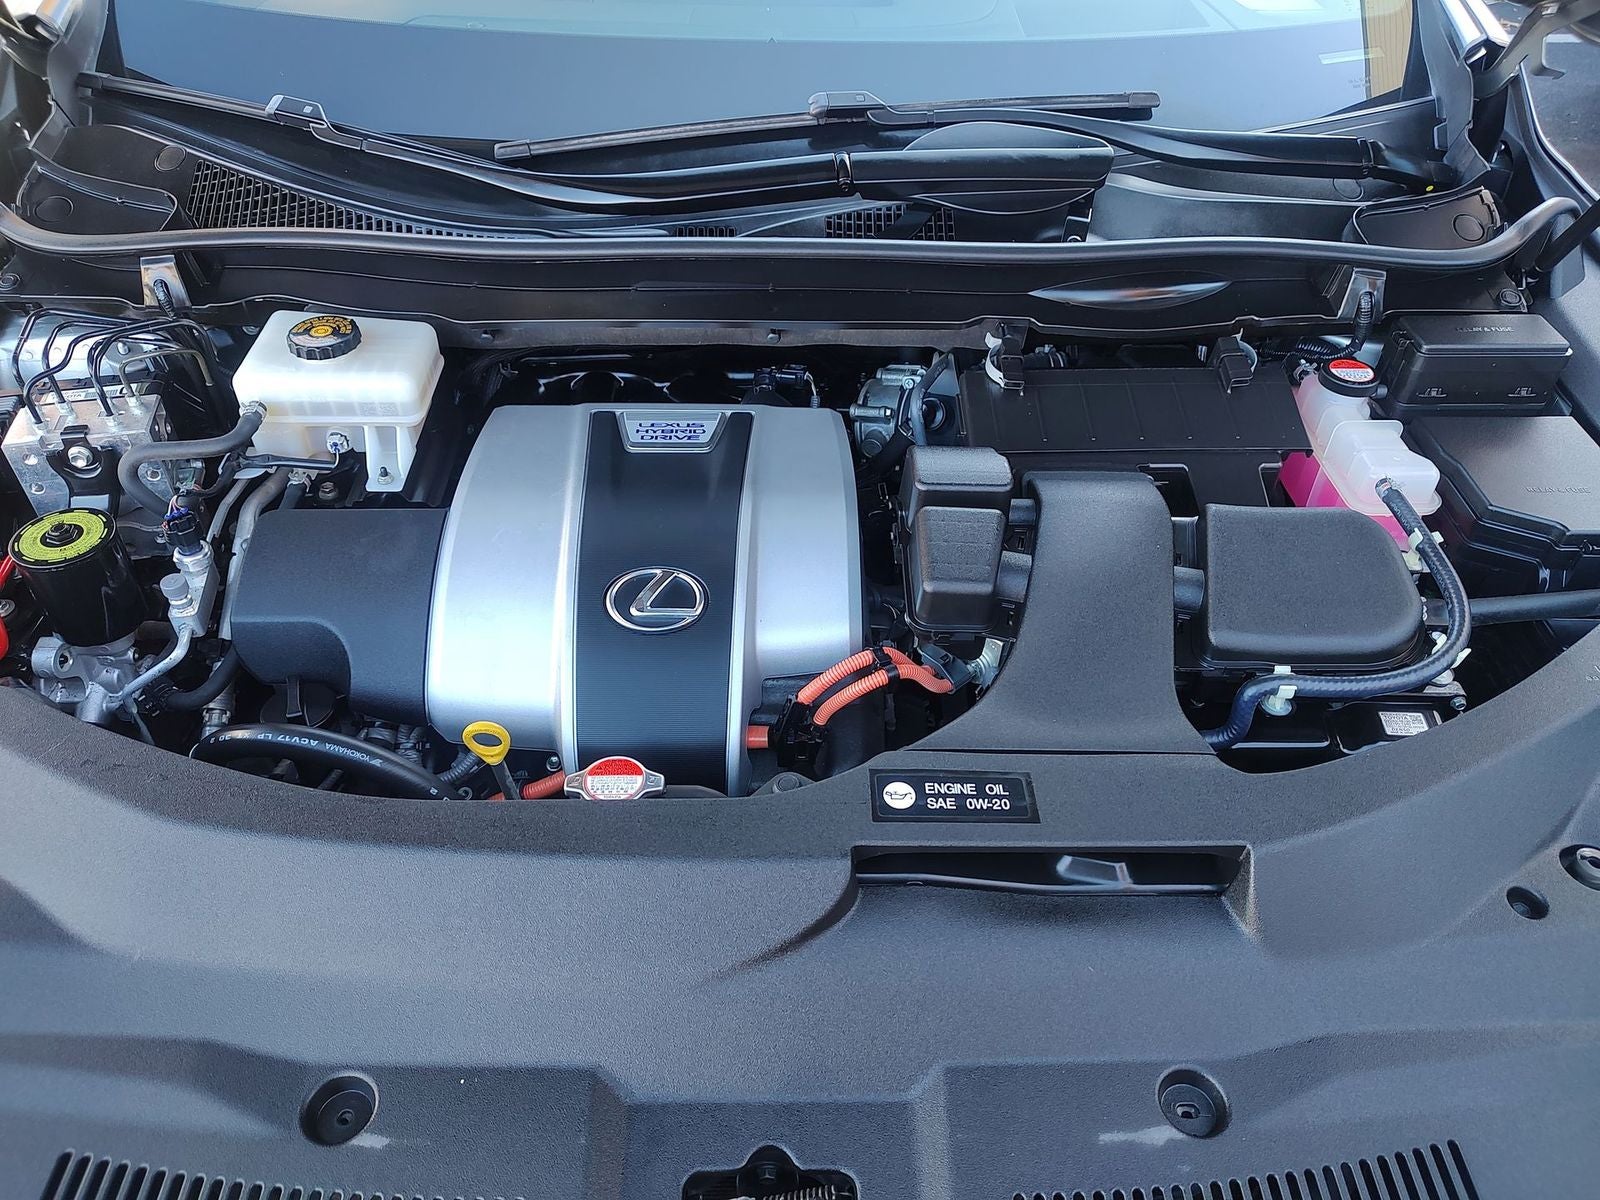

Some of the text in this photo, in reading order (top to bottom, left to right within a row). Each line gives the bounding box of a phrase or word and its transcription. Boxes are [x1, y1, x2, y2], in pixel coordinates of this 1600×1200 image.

[257, 732, 273, 740] LP
[277, 734, 319, 746] ACV17
[325, 742, 370, 761] YOKOHAMA
[924, 782, 1010, 796] ENGINE OIL
[926, 797, 1011, 811] SAE 0W-20
